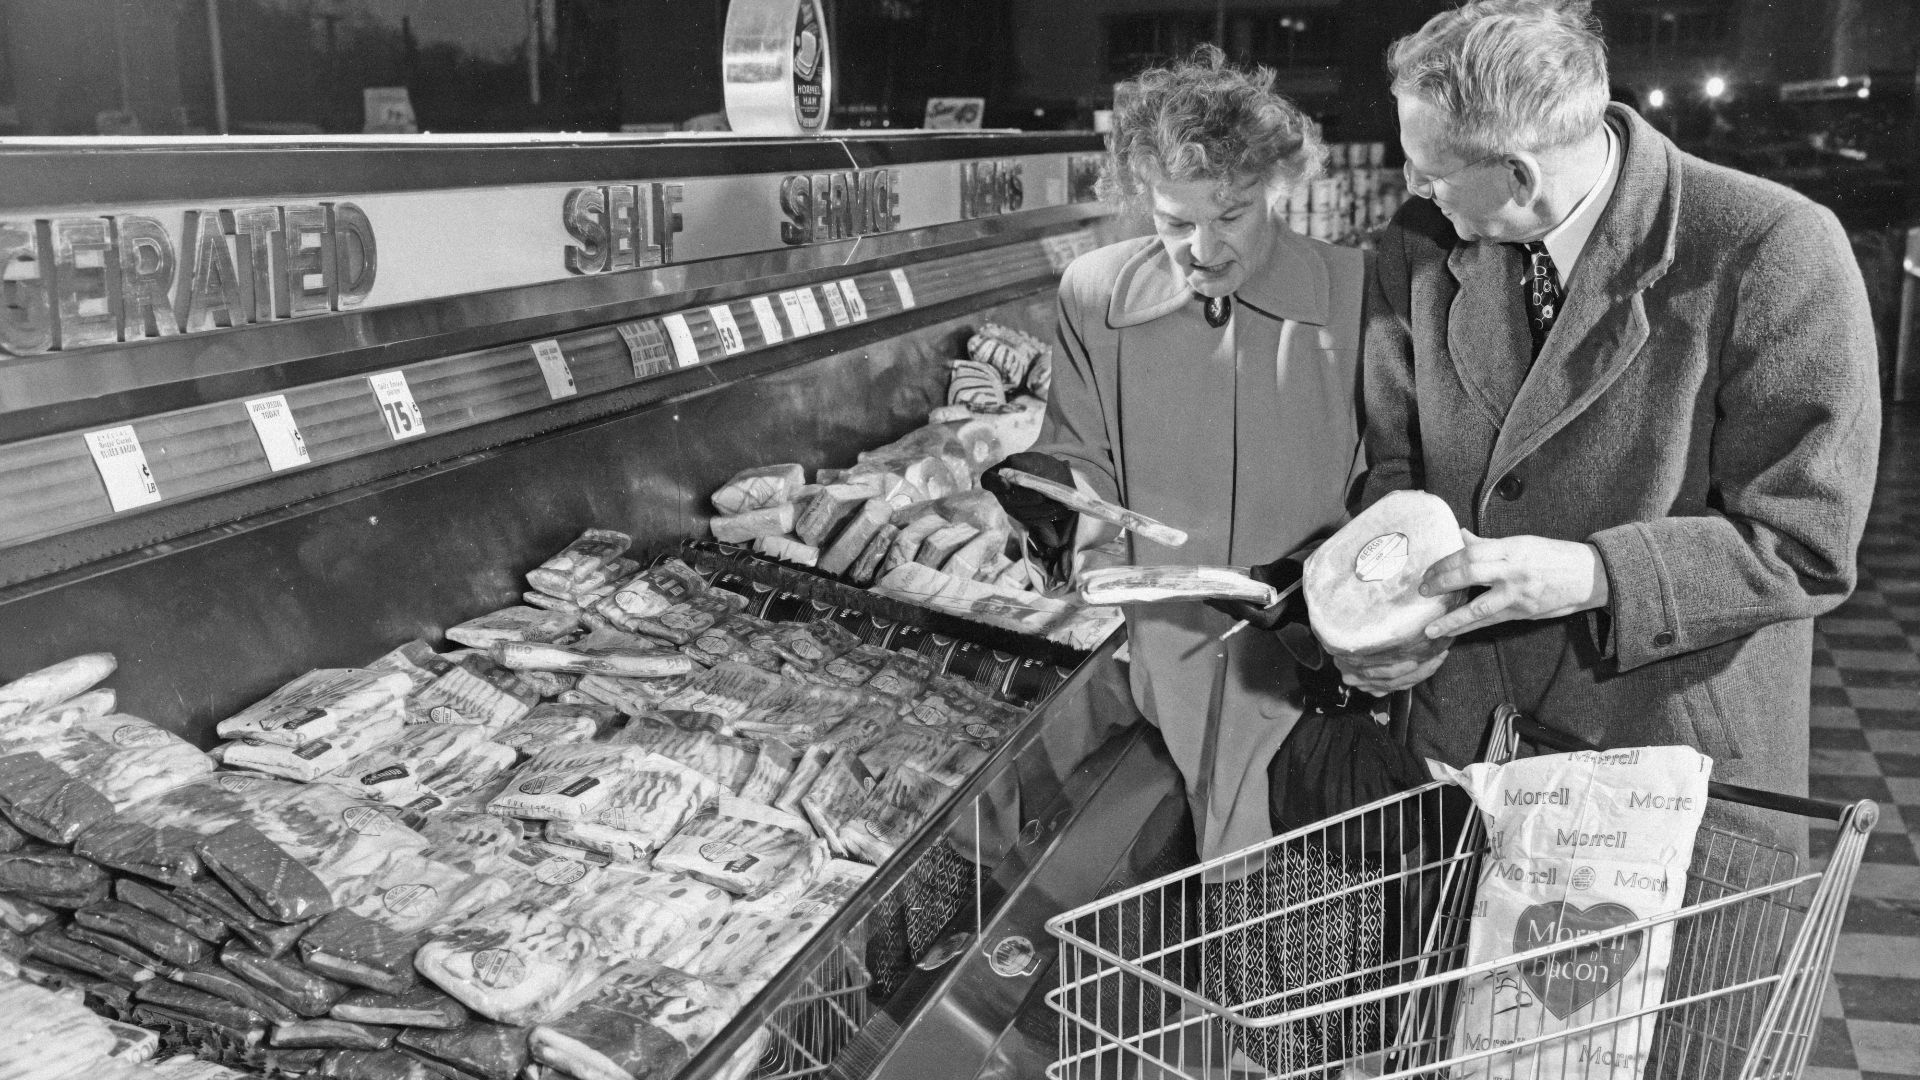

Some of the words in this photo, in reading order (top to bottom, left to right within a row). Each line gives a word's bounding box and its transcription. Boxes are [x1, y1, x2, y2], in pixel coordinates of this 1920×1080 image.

[797, 84, 821, 95] HORMEL
[563, 183, 683, 275] SELF
[780, 168, 900, 246] SERVICE
[384, 401, 412, 434] 75
[146, 482, 156, 494] LB
[1503, 787, 1571, 806] Morrell
[1556, 828, 1628, 849] Morrell
[1530, 953, 1610, 984] bacon
